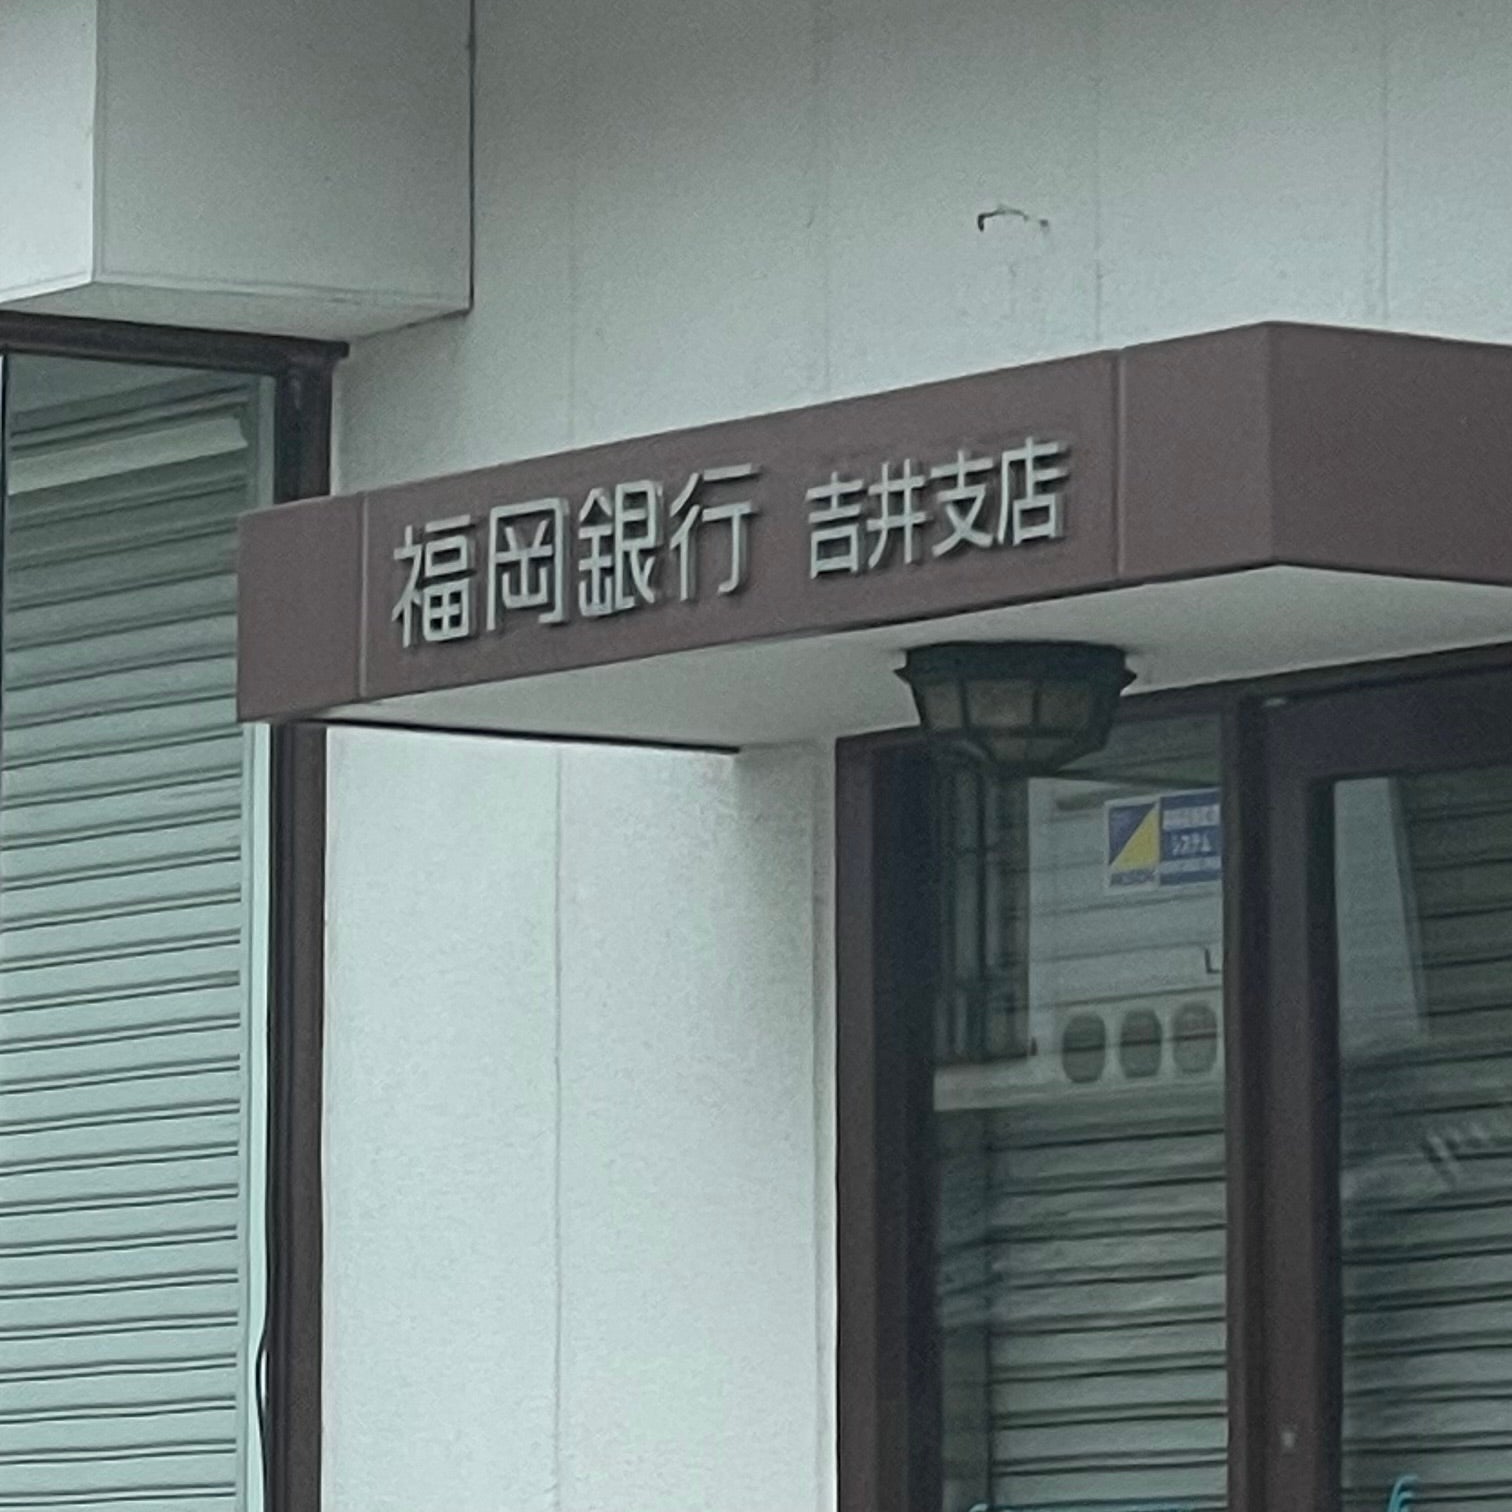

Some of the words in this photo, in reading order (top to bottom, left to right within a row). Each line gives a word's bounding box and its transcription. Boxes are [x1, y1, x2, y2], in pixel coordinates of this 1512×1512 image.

[391, 462, 760, 648] 福岡銀行
[804, 436, 1067, 579] 吉井支店
